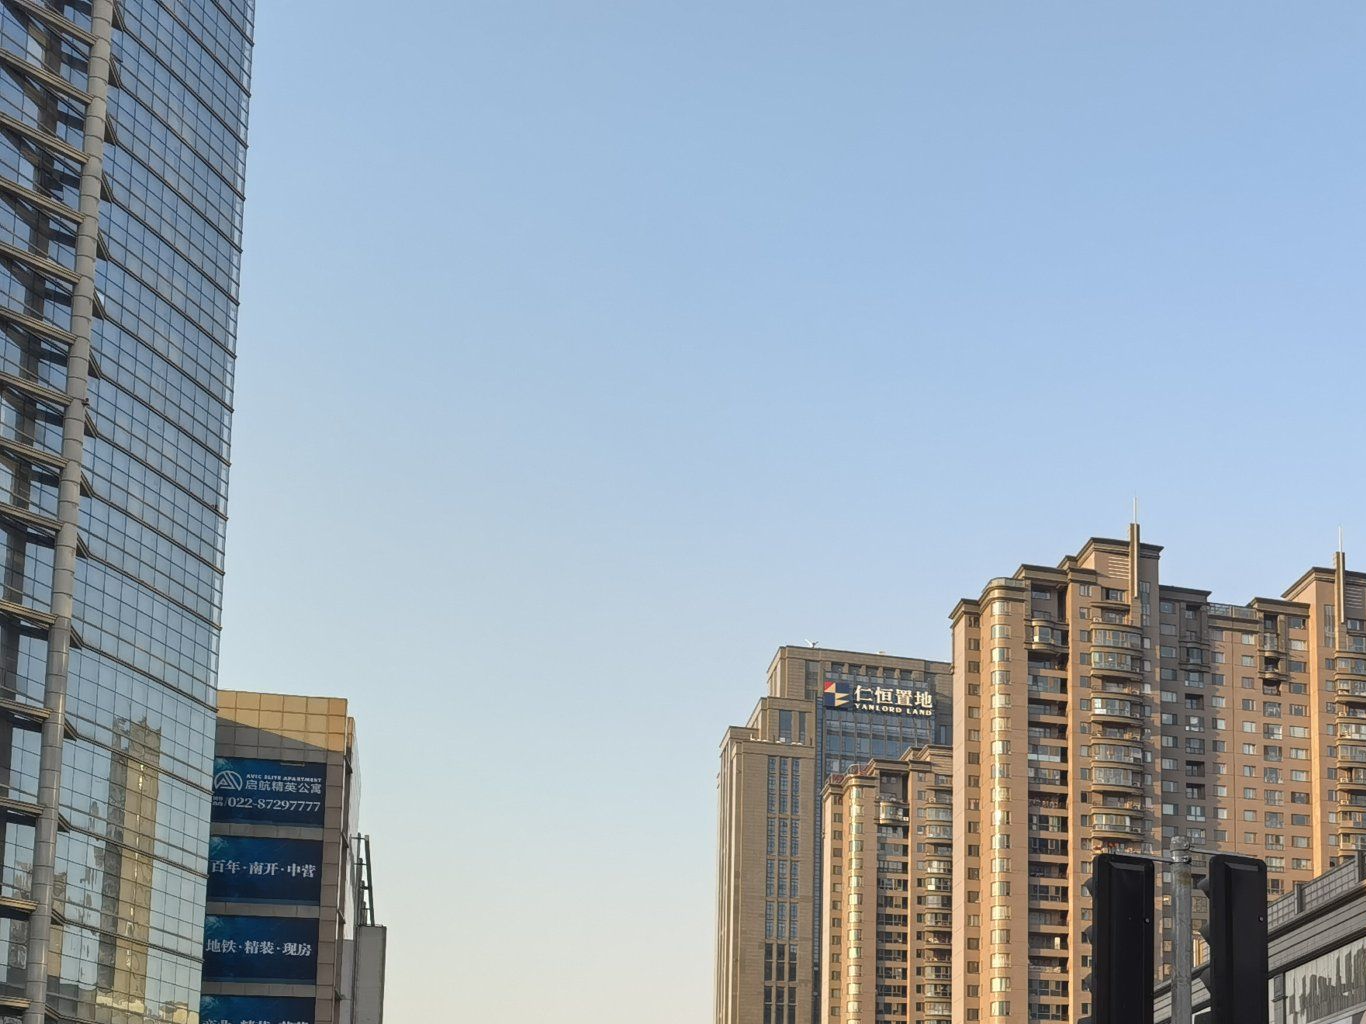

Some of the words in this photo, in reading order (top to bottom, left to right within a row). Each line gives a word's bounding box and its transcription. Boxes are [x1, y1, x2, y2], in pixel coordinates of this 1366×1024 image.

[854, 684, 933, 708] 仁恒置地
[855, 703, 902, 713] YANLORD
[906, 708, 933, 716] LAND
[245, 780, 322, 795] 启航精英公寓
[228, 797, 321, 812] 022-87297777
